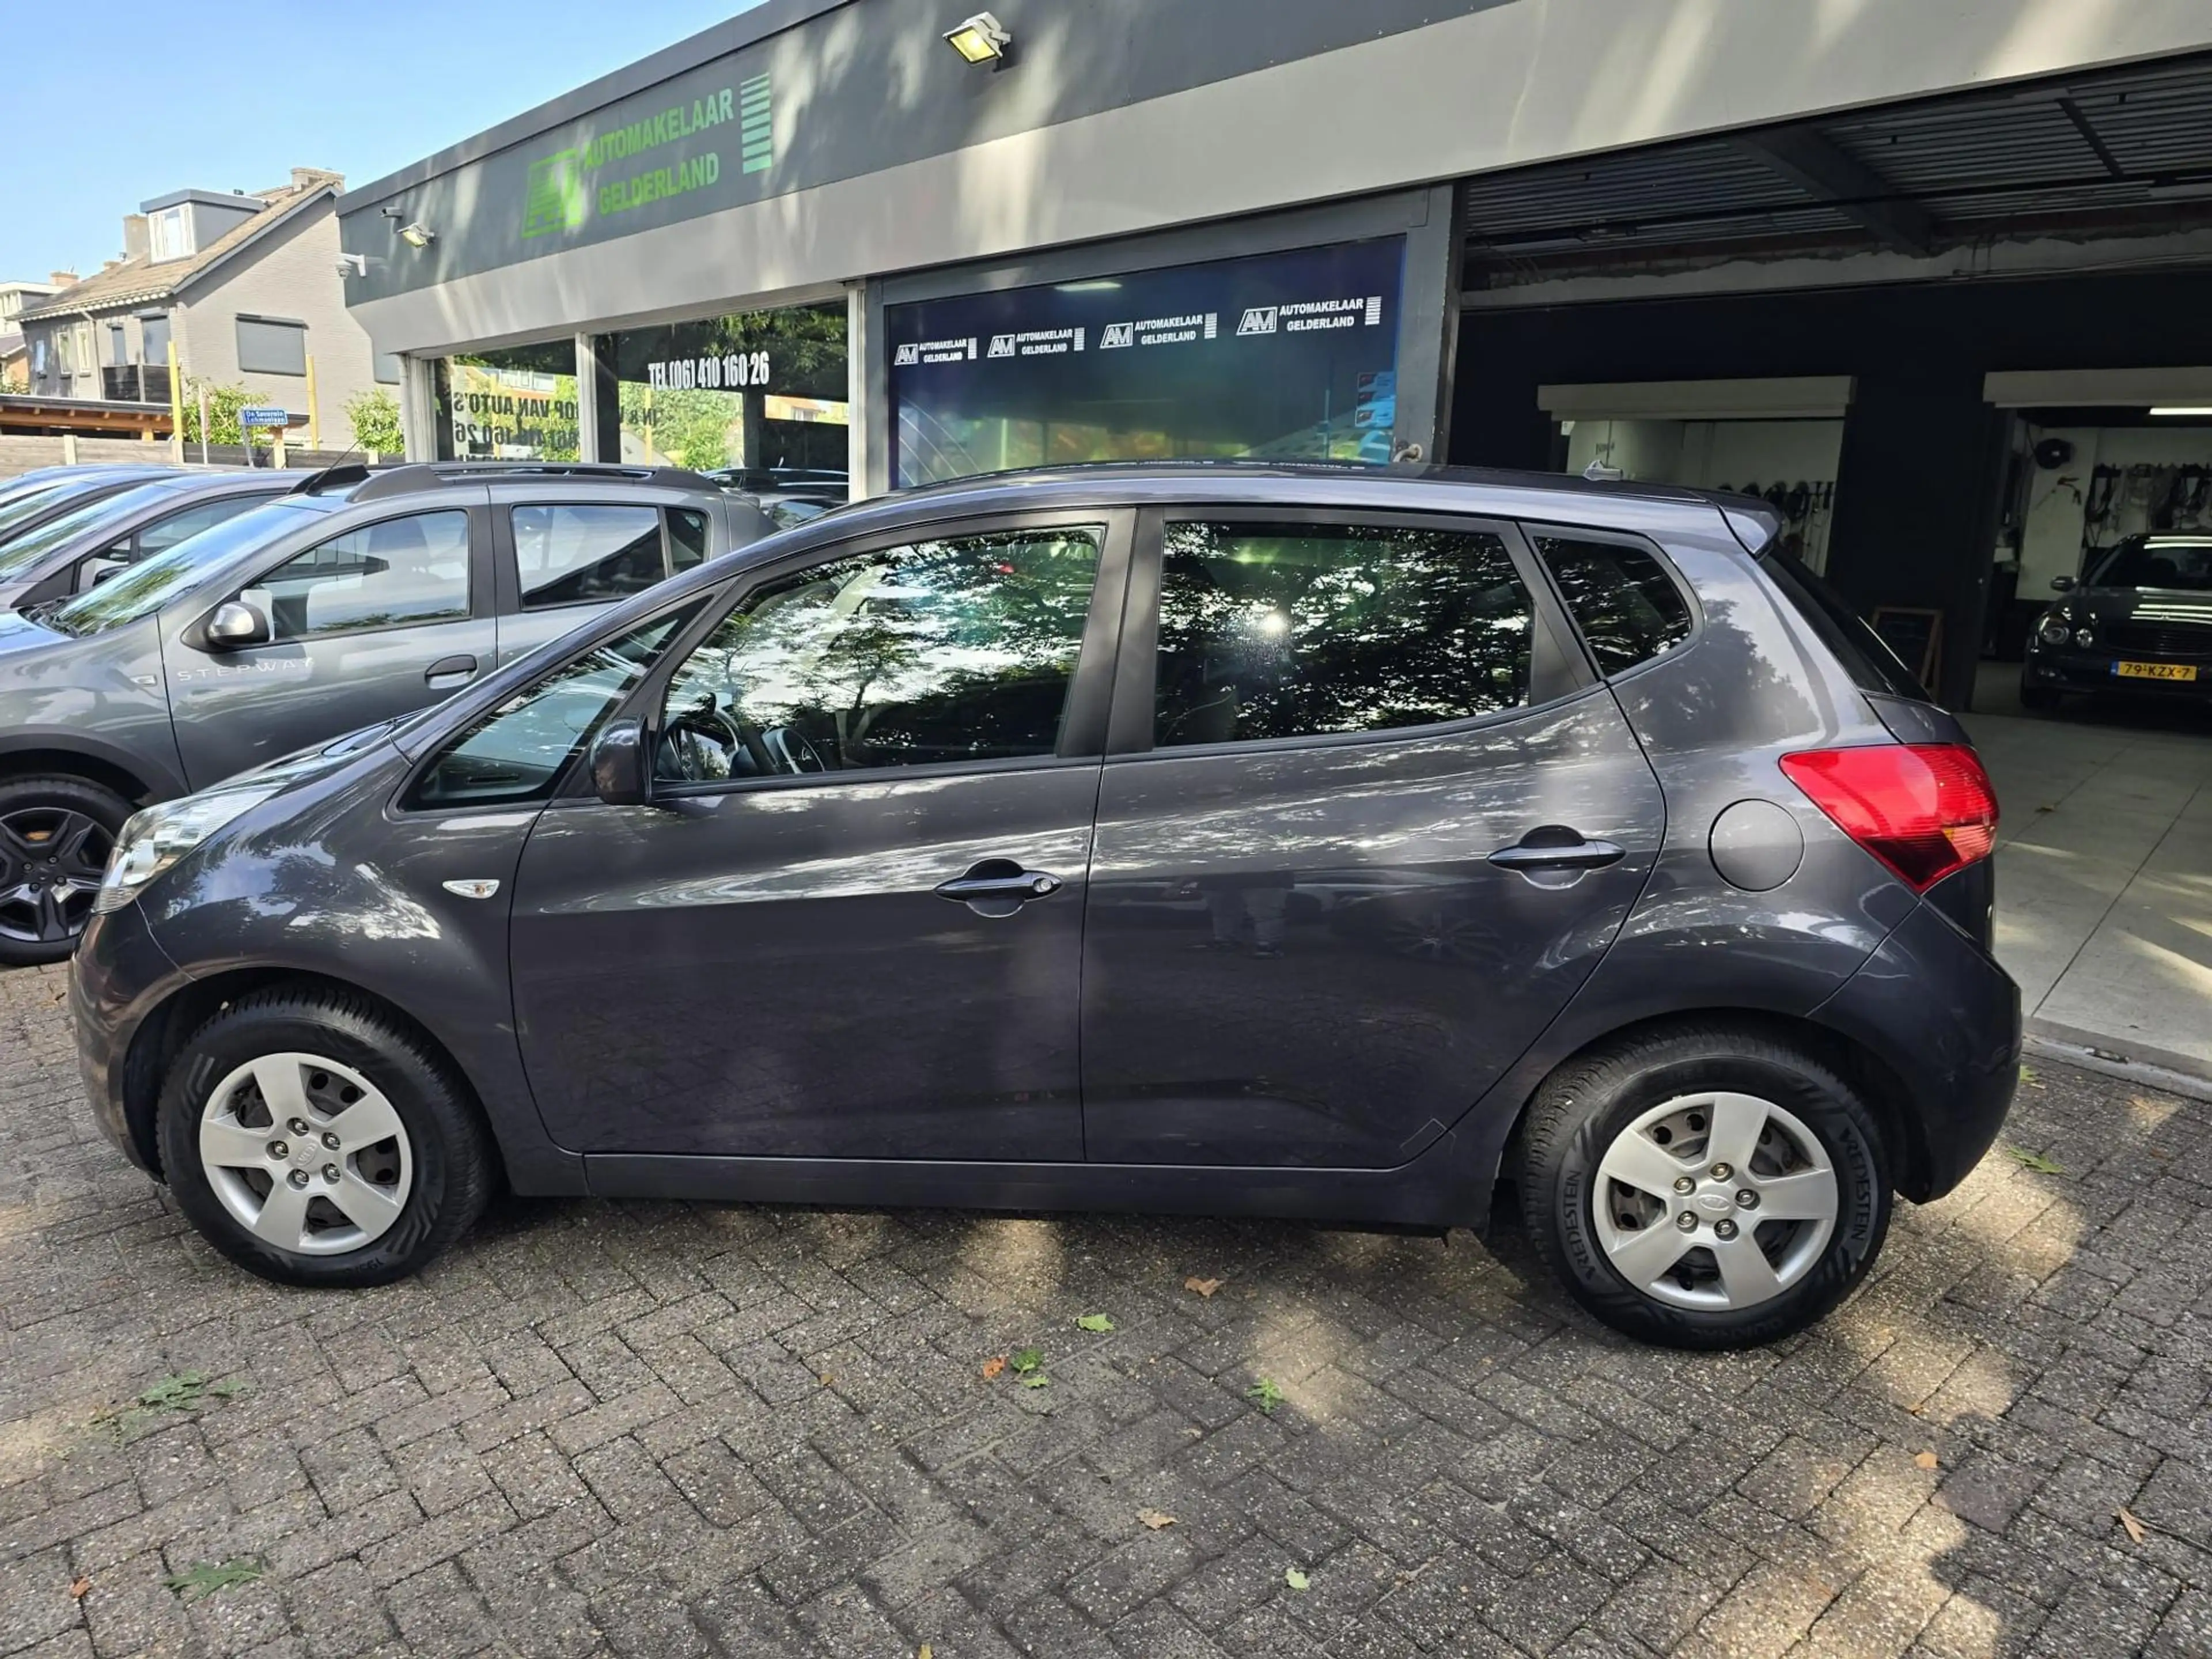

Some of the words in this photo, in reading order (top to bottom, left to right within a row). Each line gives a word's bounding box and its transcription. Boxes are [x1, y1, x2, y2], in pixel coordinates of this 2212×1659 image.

[583, 88, 734, 171] AUTOMAKELAAR
[599, 152, 719, 215] GELDERLAND
[1279, 298, 1364, 316] AUTOMAKELAAR
[1135, 315, 1203, 331] AUTOMAKELAAR
[1287, 316, 1355, 331] GELDERLAND
[1016, 328, 1073, 342] AUTOMAKELAAR
[1141, 331, 1196, 345] GELDERLAND
[919, 338, 967, 351] AUTOMAKELAAR
[1021, 343, 1067, 355] GELDERLAND
[923, 351, 963, 363] GELDERLAND
[669, 359, 695, 390] (06)
[698, 356, 721, 388] 410
[722, 353, 748, 387] 160
[749, 350, 770, 385] 26
[177, 657, 313, 681] STEPWAY
[2124, 663, 2190, 679] 79-KZX-7
[1839, 1127, 1872, 1241] VREDESTEIN
[1562, 1170, 1596, 1280] VREDESTEIN
